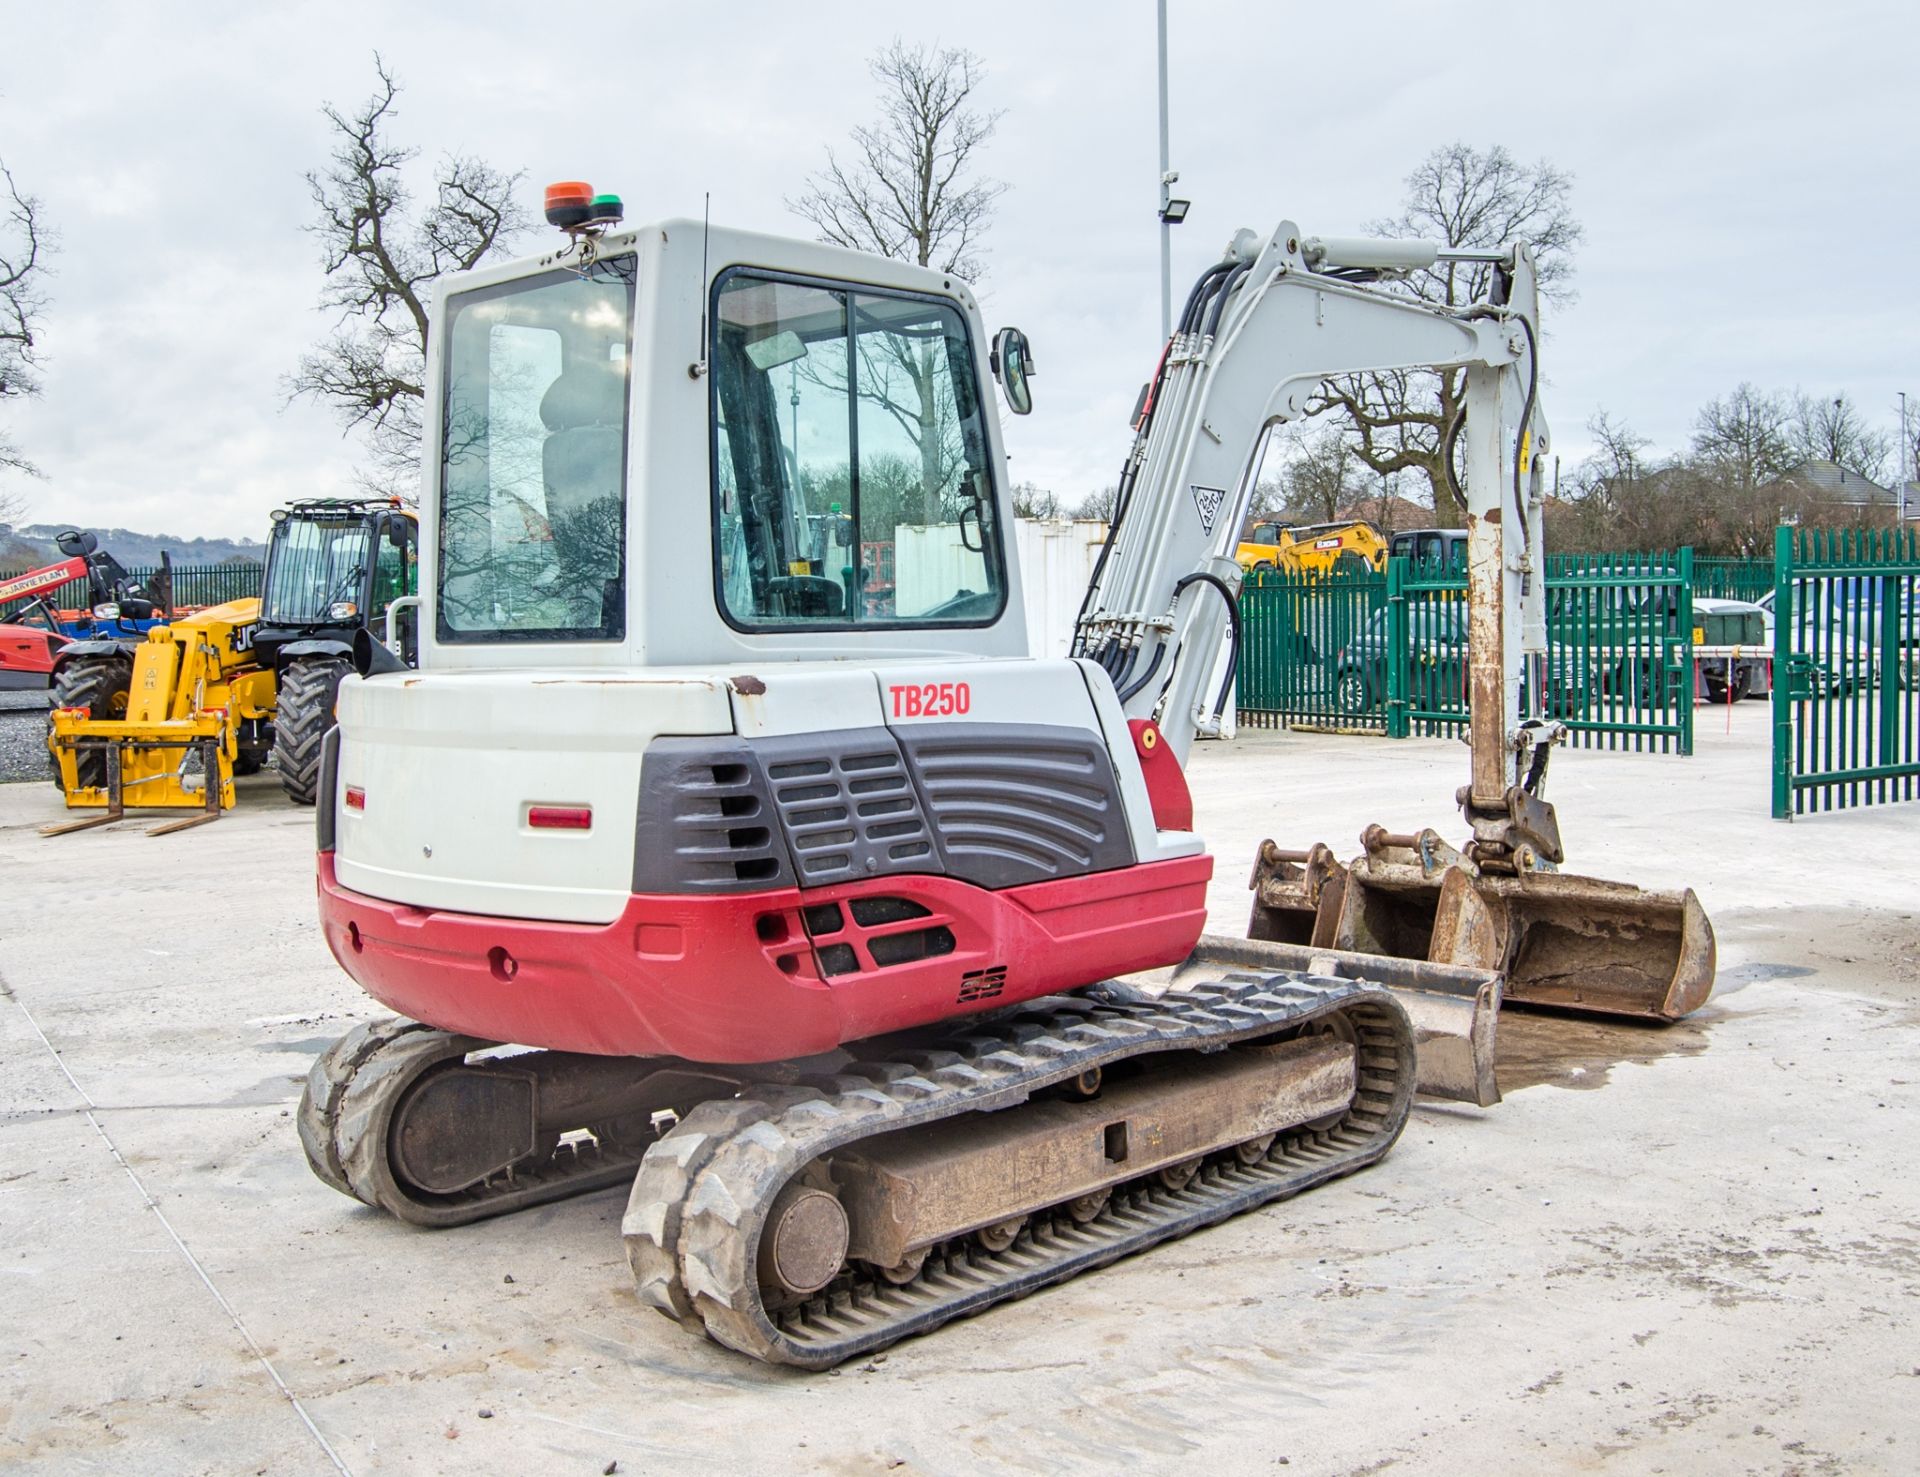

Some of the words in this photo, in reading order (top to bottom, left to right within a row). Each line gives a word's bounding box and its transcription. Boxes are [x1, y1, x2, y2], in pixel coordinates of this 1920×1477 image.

[9, 579, 37, 594] JARVIE
[39, 568, 66, 584] PLANT
[236, 624, 260, 651] JC
[889, 682, 970, 717] TB250
